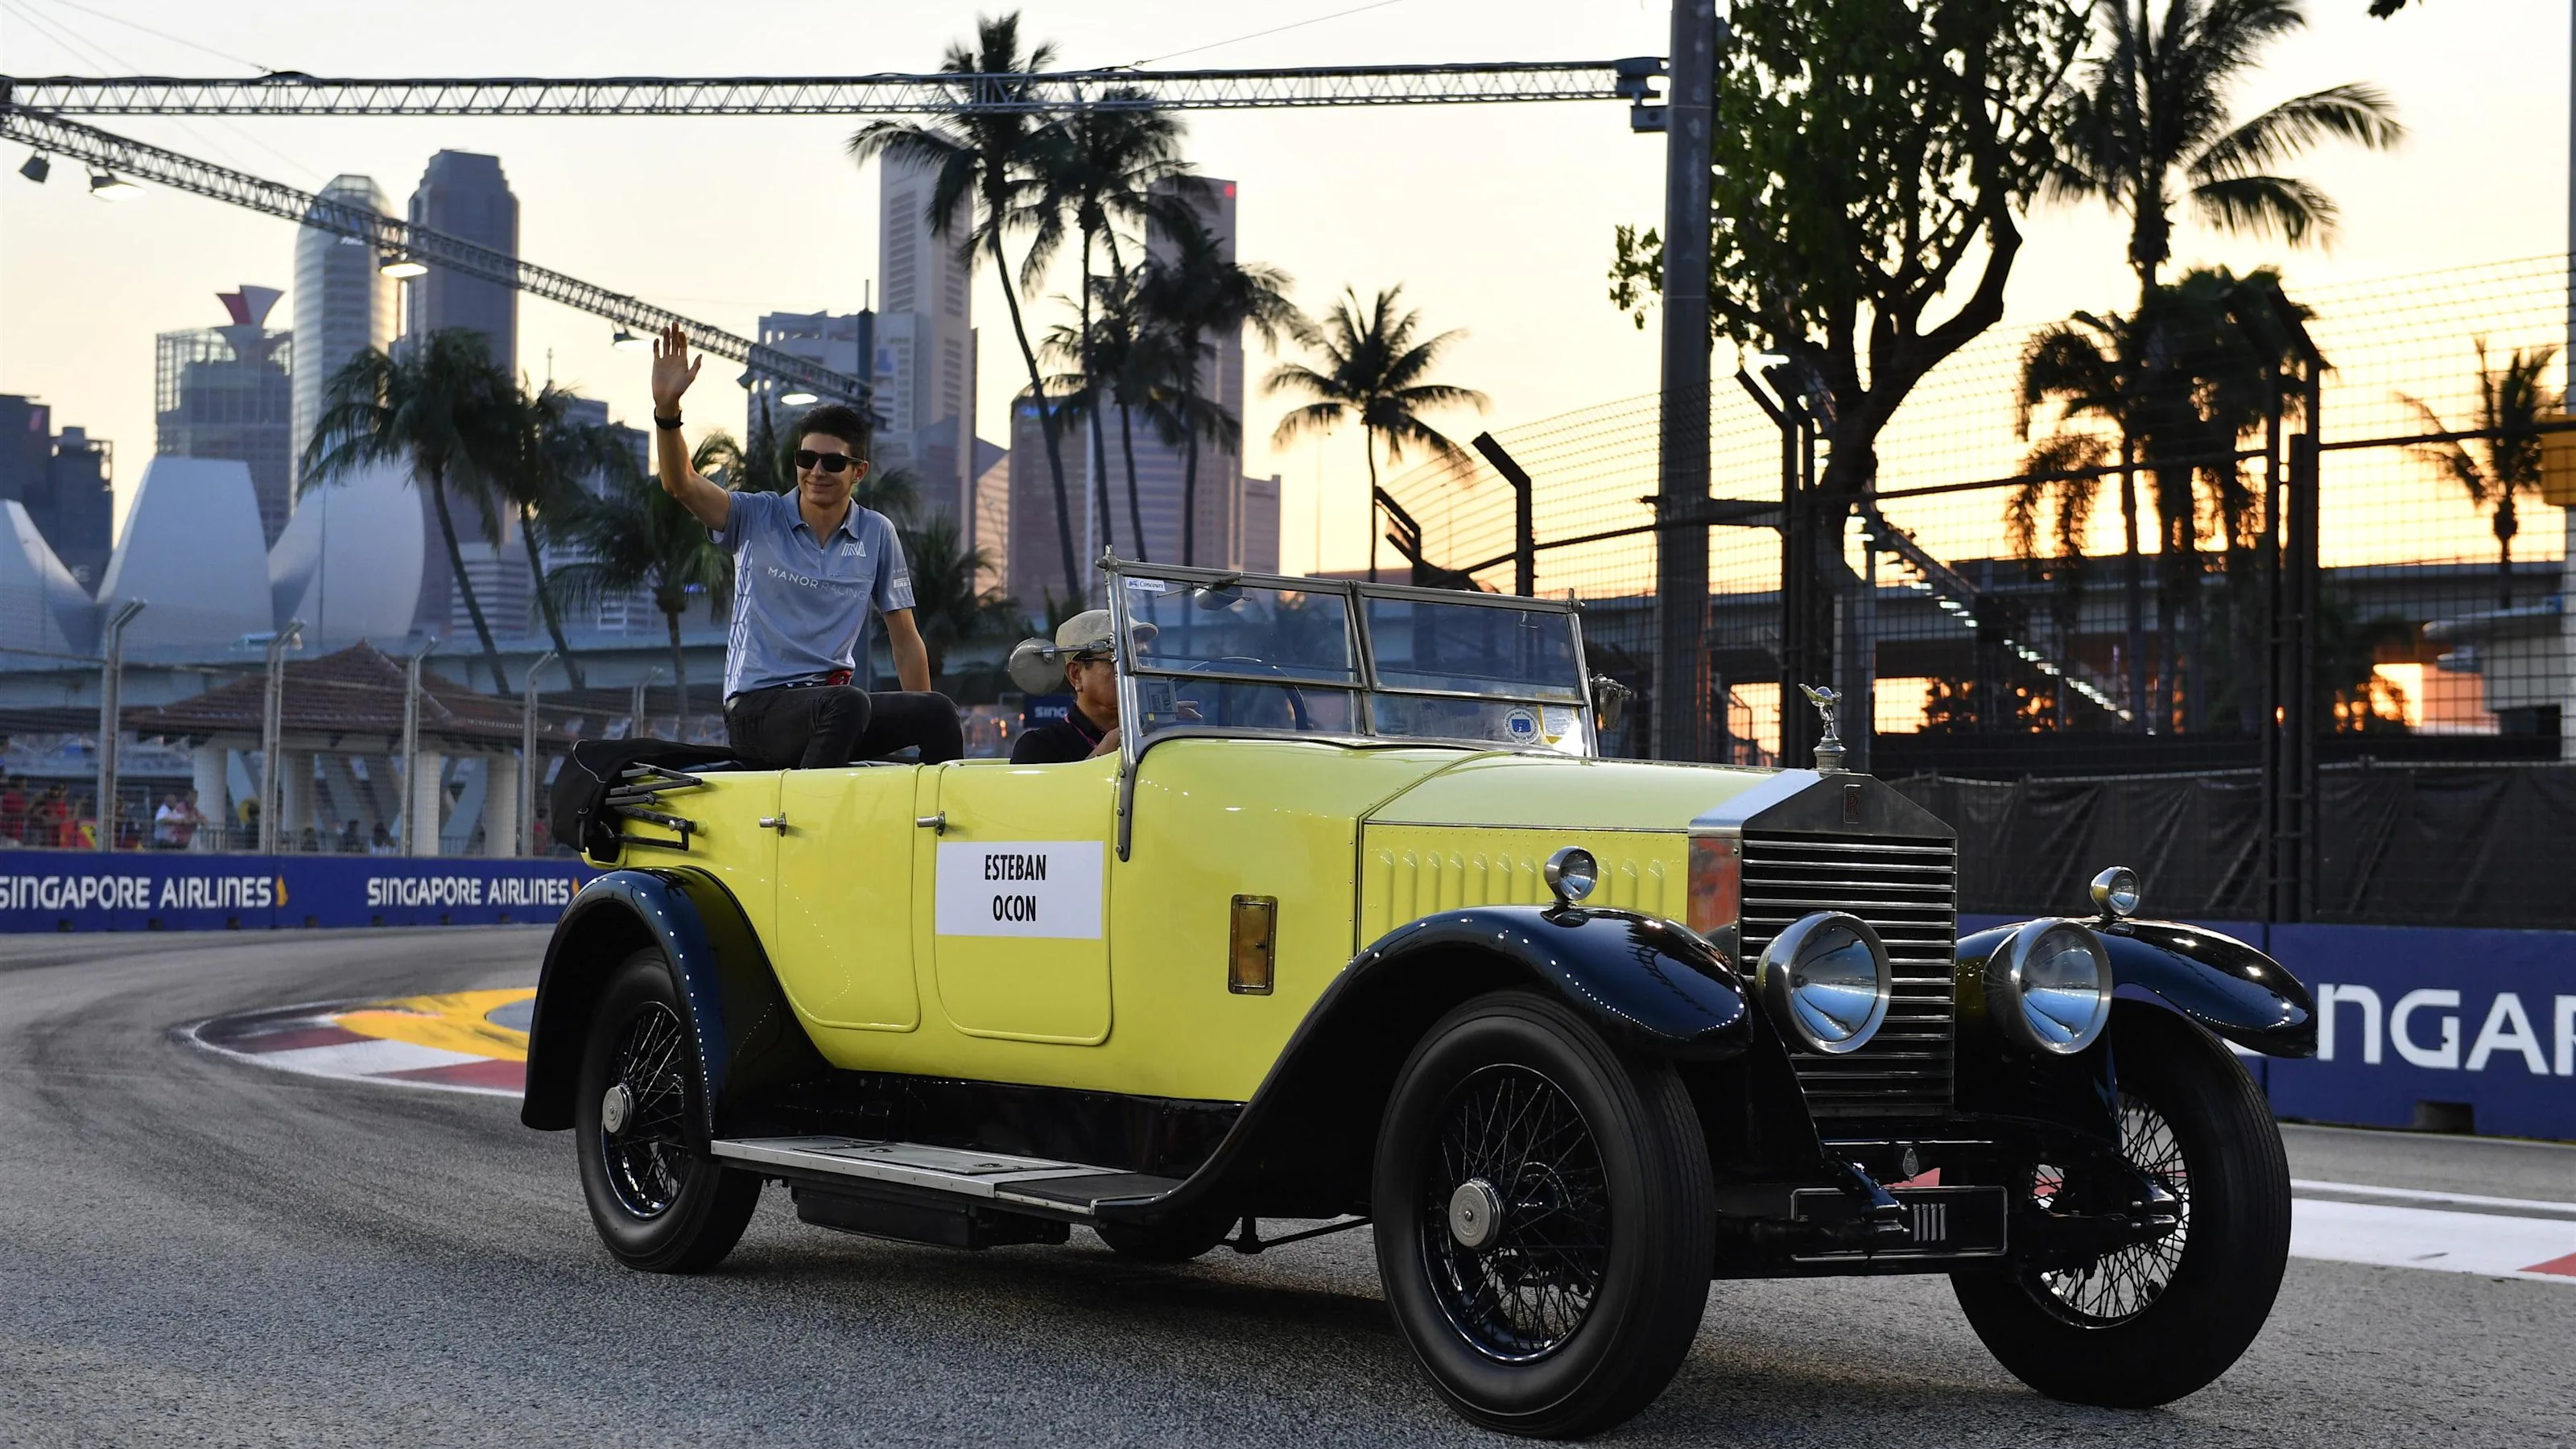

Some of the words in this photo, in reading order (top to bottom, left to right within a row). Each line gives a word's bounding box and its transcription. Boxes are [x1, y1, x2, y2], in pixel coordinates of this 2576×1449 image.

[767, 566, 819, 589] MANOR
[821, 582, 867, 601] RACING
[985, 854, 1046, 881] ESTEBAN
[0, 875, 151, 910] SINGAPORE
[159, 877, 272, 909] AIRLINES
[367, 876, 482, 906] SINGAPORE
[487, 877, 570, 906] AIRLINES
[993, 894, 1036, 922] OCON
